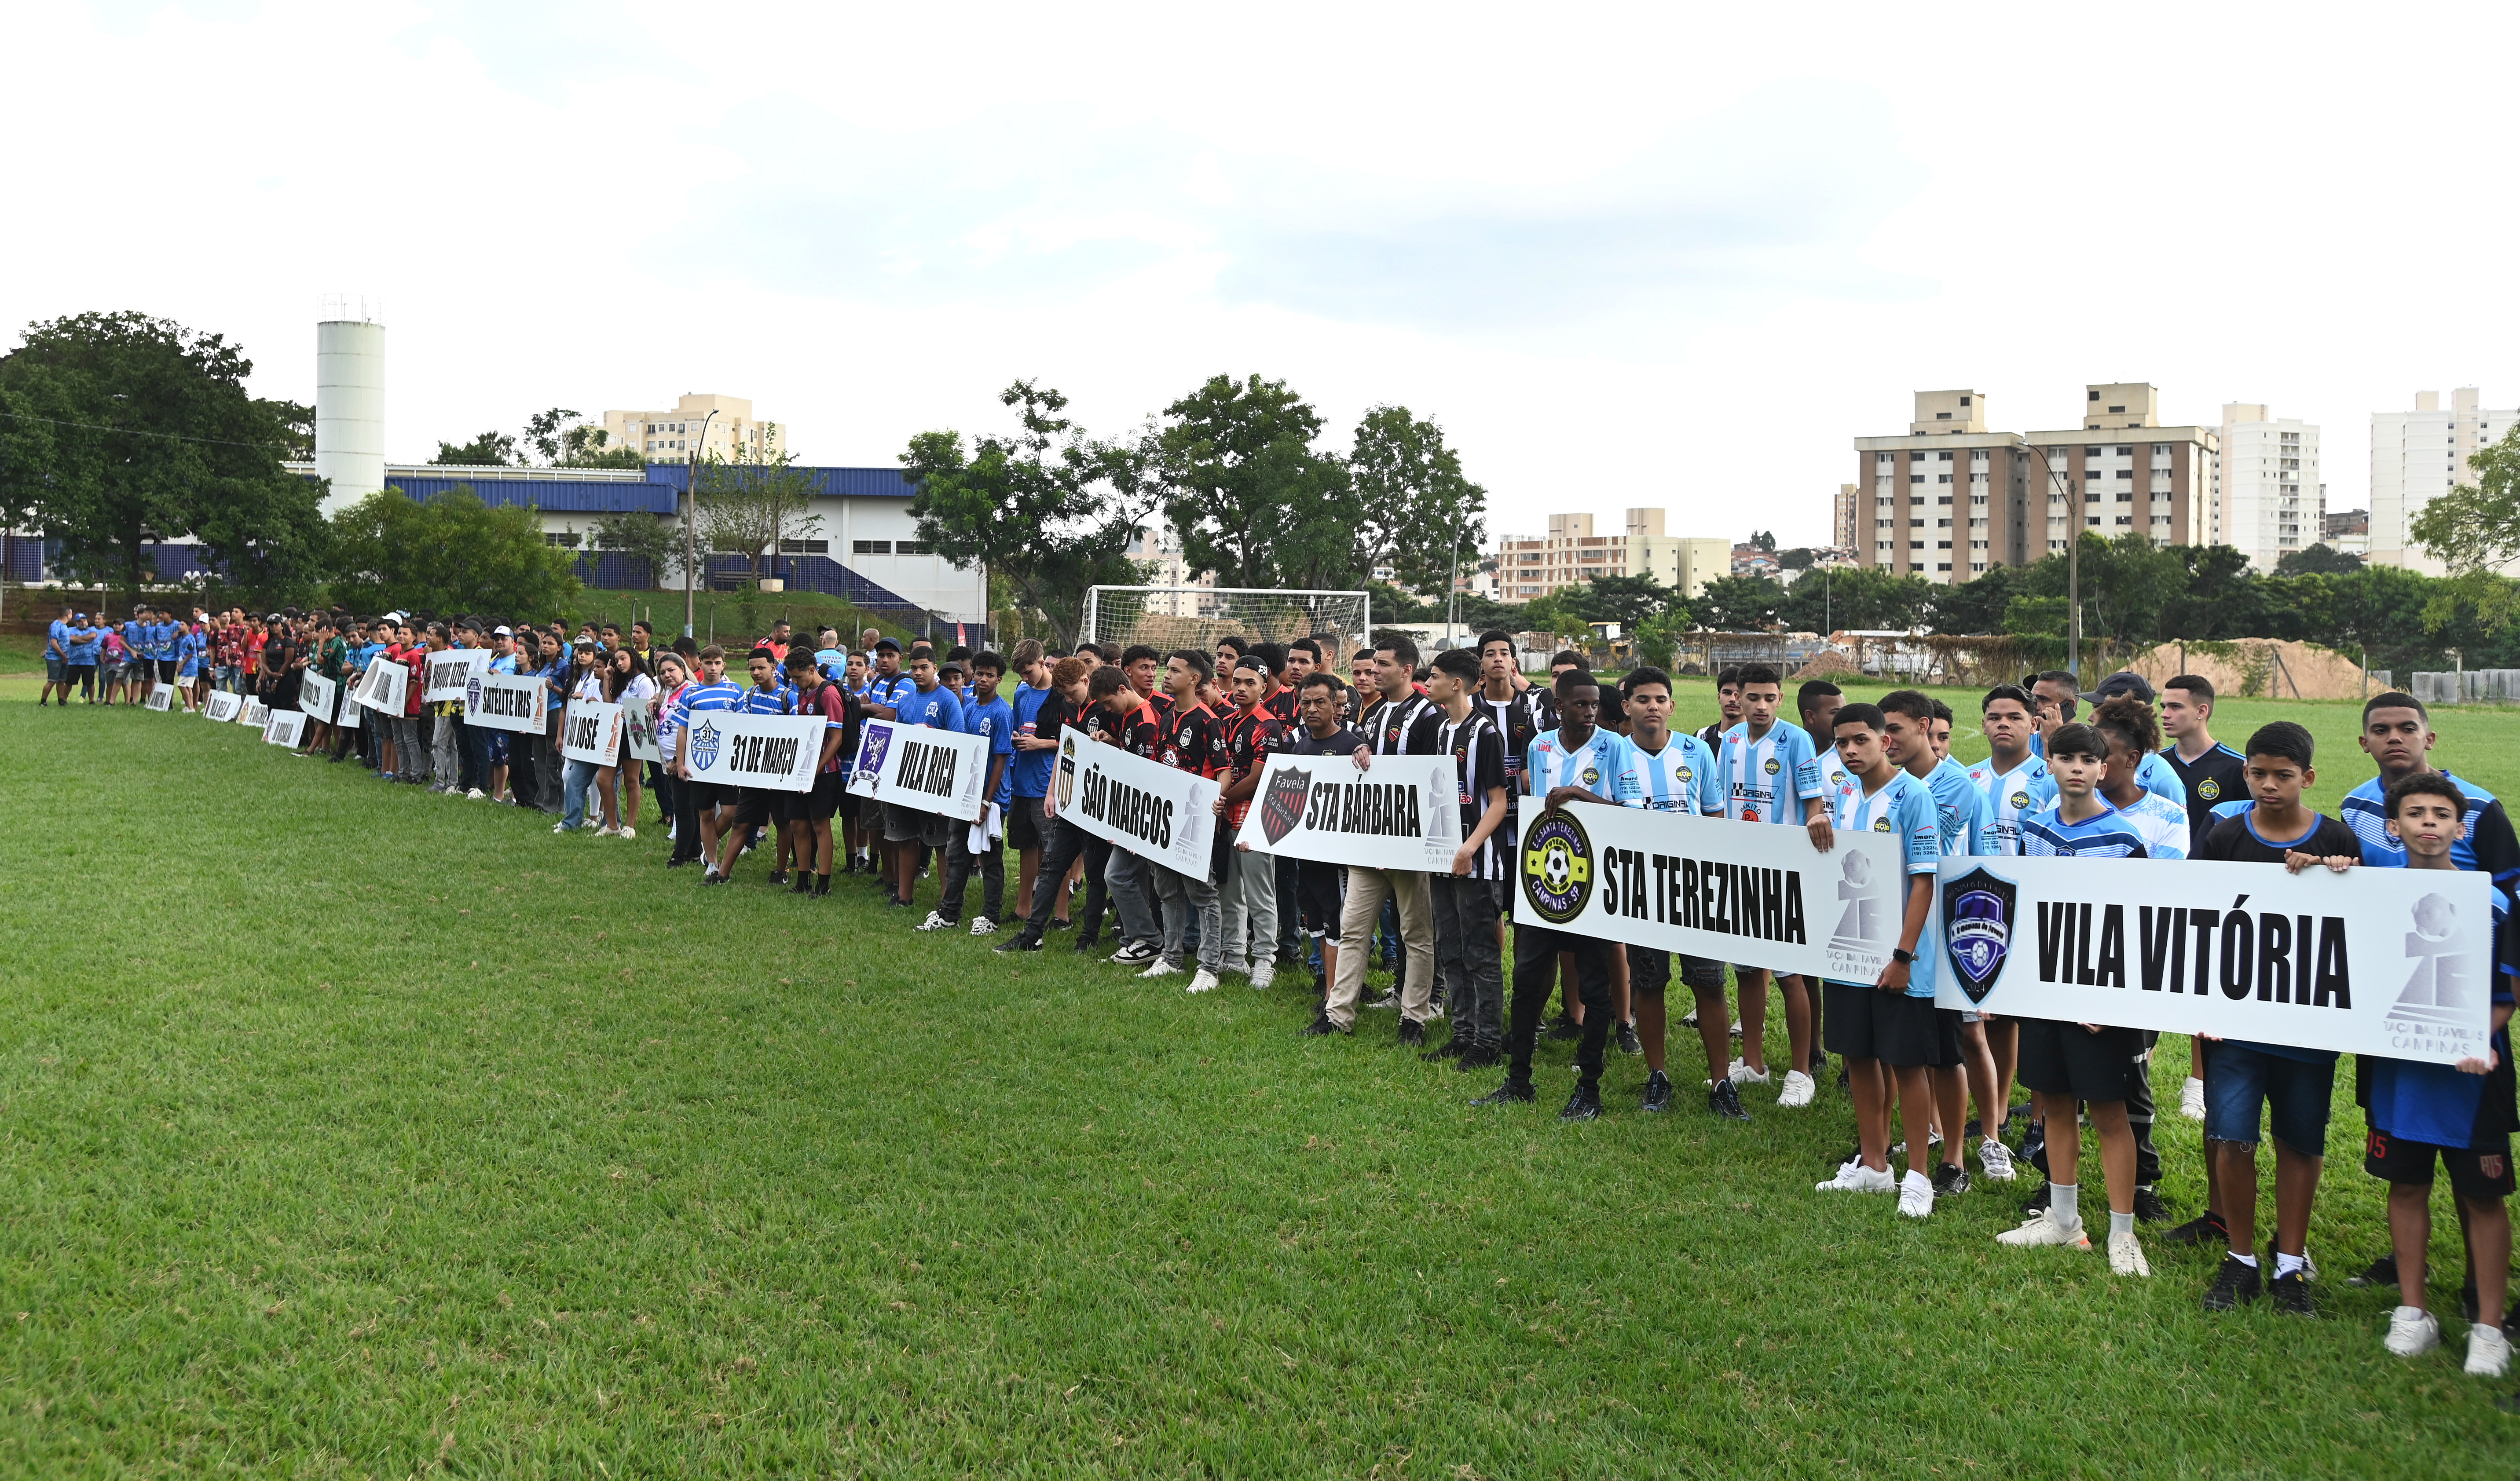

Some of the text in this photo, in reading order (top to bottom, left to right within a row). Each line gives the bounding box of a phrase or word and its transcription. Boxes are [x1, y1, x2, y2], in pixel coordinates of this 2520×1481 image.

[432, 662, 470, 691] PARQUE OZIEL
[483, 682, 531, 719] SATÉLITE IRIS
[575, 713, 600, 750] JOSÉ
[703, 730, 711, 739] 31
[730, 734, 798, 783] 31 DE MARÇO
[896, 741, 957, 798] VILA RICA
[1275, 775, 1305, 790] Favela
[1082, 762, 1173, 849] SÃO MARCOS
[1305, 774, 1421, 837] STA BÁRBARA
[1740, 802, 1761, 815] PAKITO
[1539, 822, 1556, 838] SANTA
[1558, 822, 1583, 854] TEREZINHA
[1532, 880, 1567, 911] CAMPINAS
[1570, 885, 1580, 902] SP
[1603, 846, 1806, 945] STA TEREZINHA
[2037, 894, 2352, 1009] VILA VITÓRIA
[1832, 962, 1882, 977] CAMPINAS
[2392, 1035, 2470, 1056] CAMPINAS
